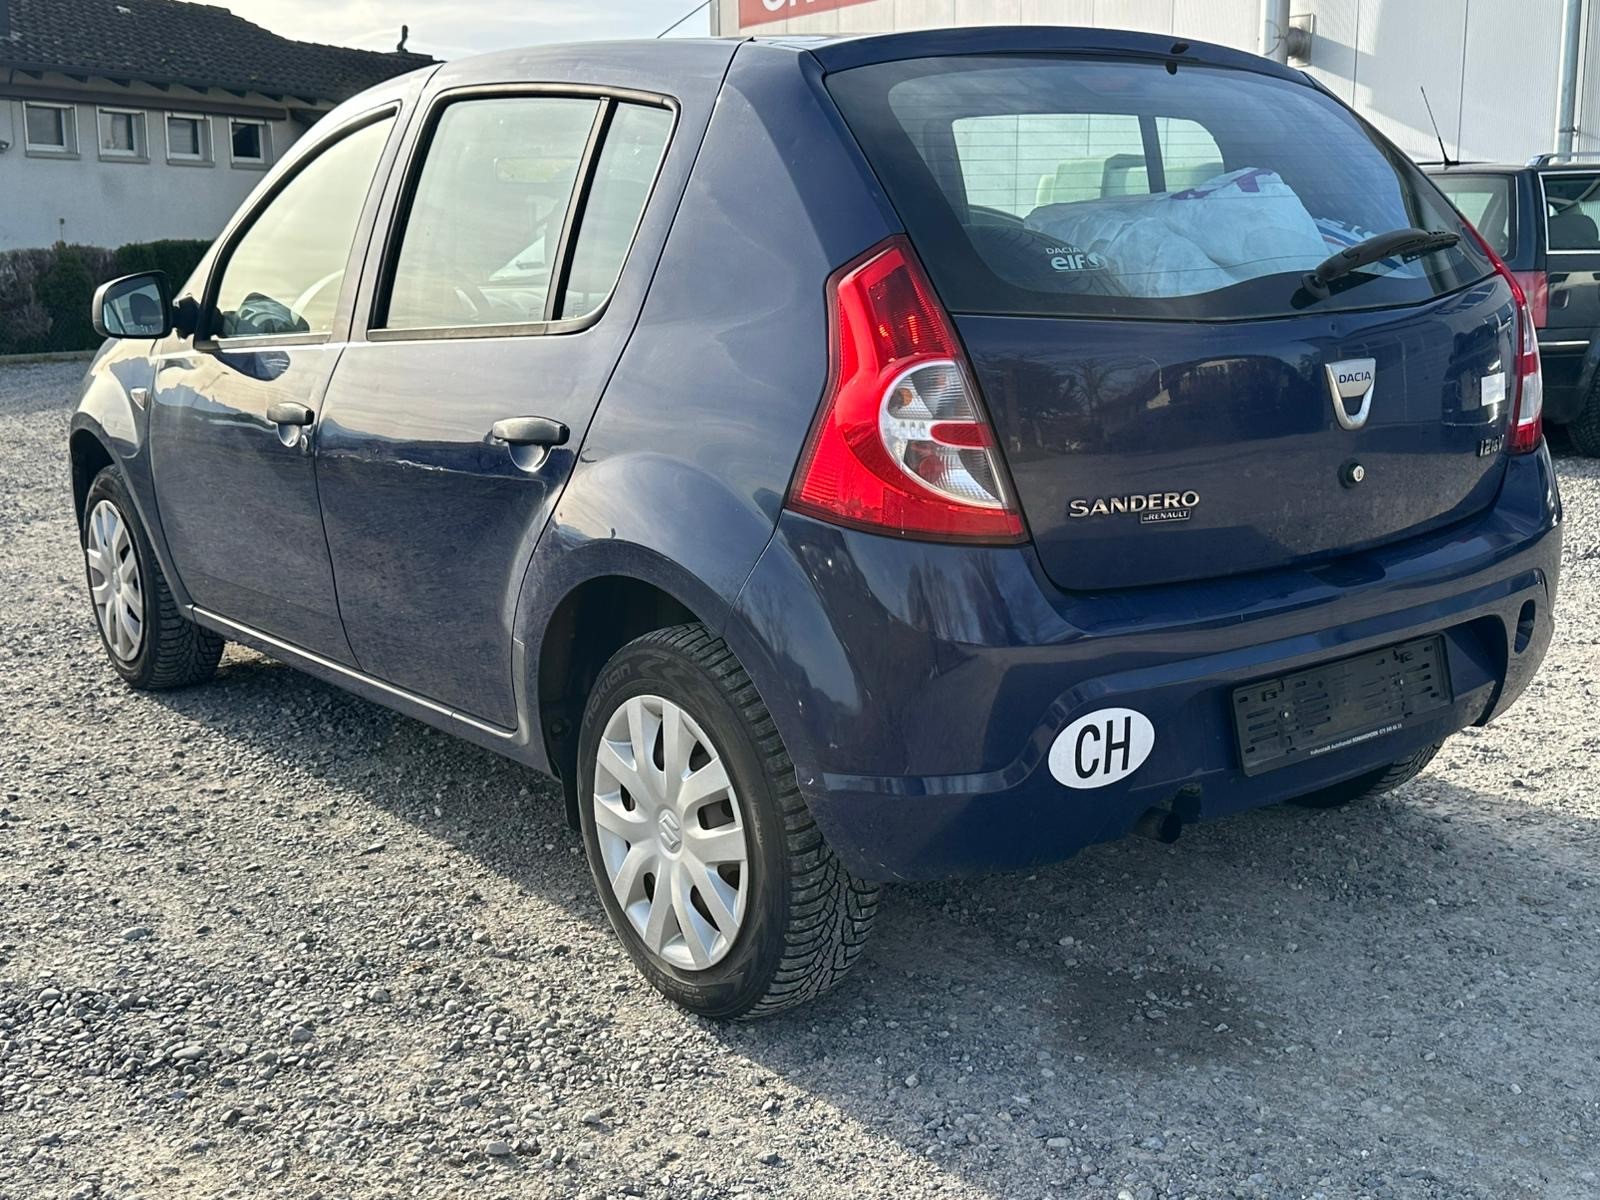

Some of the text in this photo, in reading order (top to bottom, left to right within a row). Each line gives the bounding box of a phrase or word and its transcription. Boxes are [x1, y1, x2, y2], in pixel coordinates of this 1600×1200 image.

[1045, 246, 1081, 254] DACIA
[1051, 254, 1085, 270] elf
[1338, 371, 1372, 384] DACIA
[1069, 490, 1200, 518] SANDERO
[1149, 510, 1188, 520] RENAULT
[1075, 716, 1131, 779] CH
